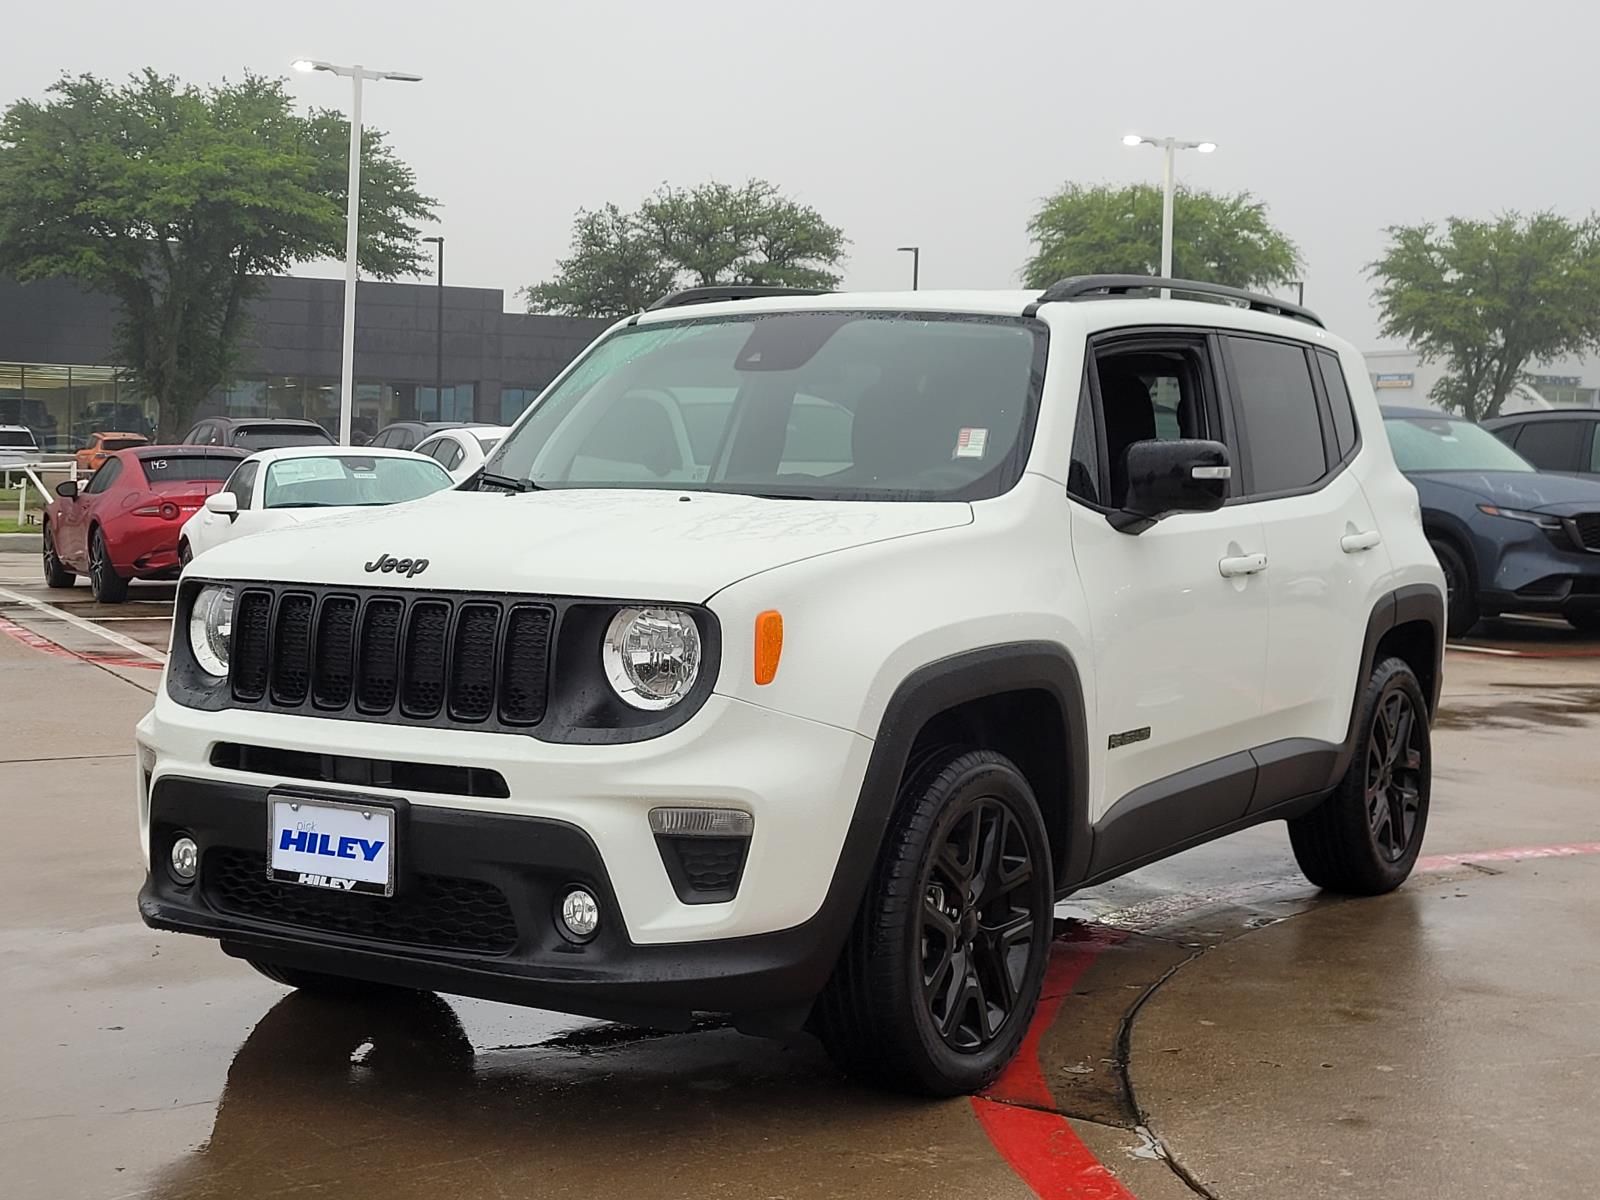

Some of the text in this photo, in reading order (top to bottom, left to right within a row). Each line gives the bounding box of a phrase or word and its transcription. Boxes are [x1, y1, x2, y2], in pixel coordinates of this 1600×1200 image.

[151, 460, 167, 469] 143
[365, 553, 429, 578] Jeep
[279, 829, 384, 862] HILEY
[298, 873, 357, 890] HILEY
